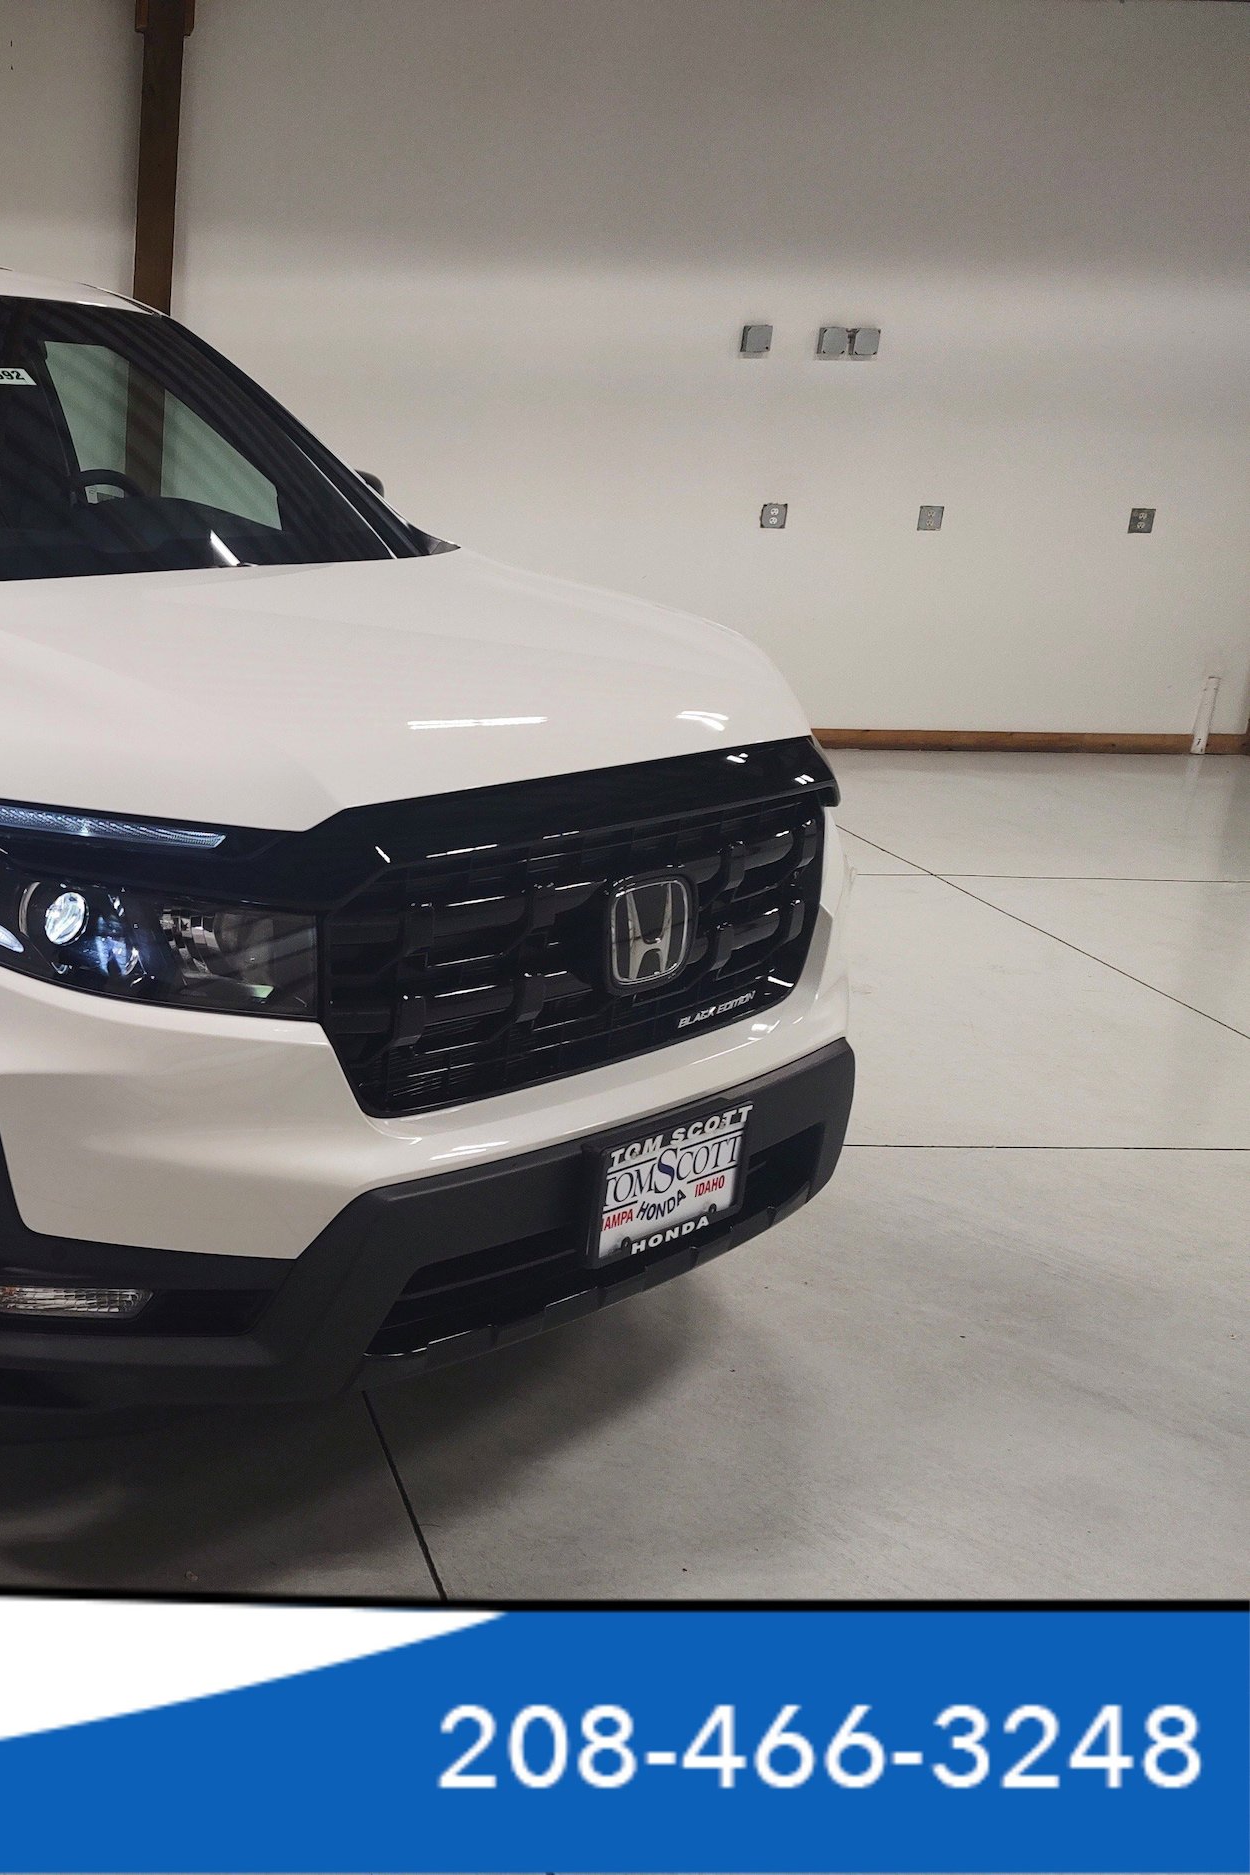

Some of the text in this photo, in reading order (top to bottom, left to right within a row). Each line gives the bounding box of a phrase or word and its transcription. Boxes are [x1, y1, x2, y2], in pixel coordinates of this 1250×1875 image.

[677, 990, 756, 1029] BLACK EDITION
[610, 1104, 753, 1168] TOM SCOTT
[602, 1174, 725, 1231] AMPA HONDA IDAHO
[630, 1216, 709, 1255] HONDA
